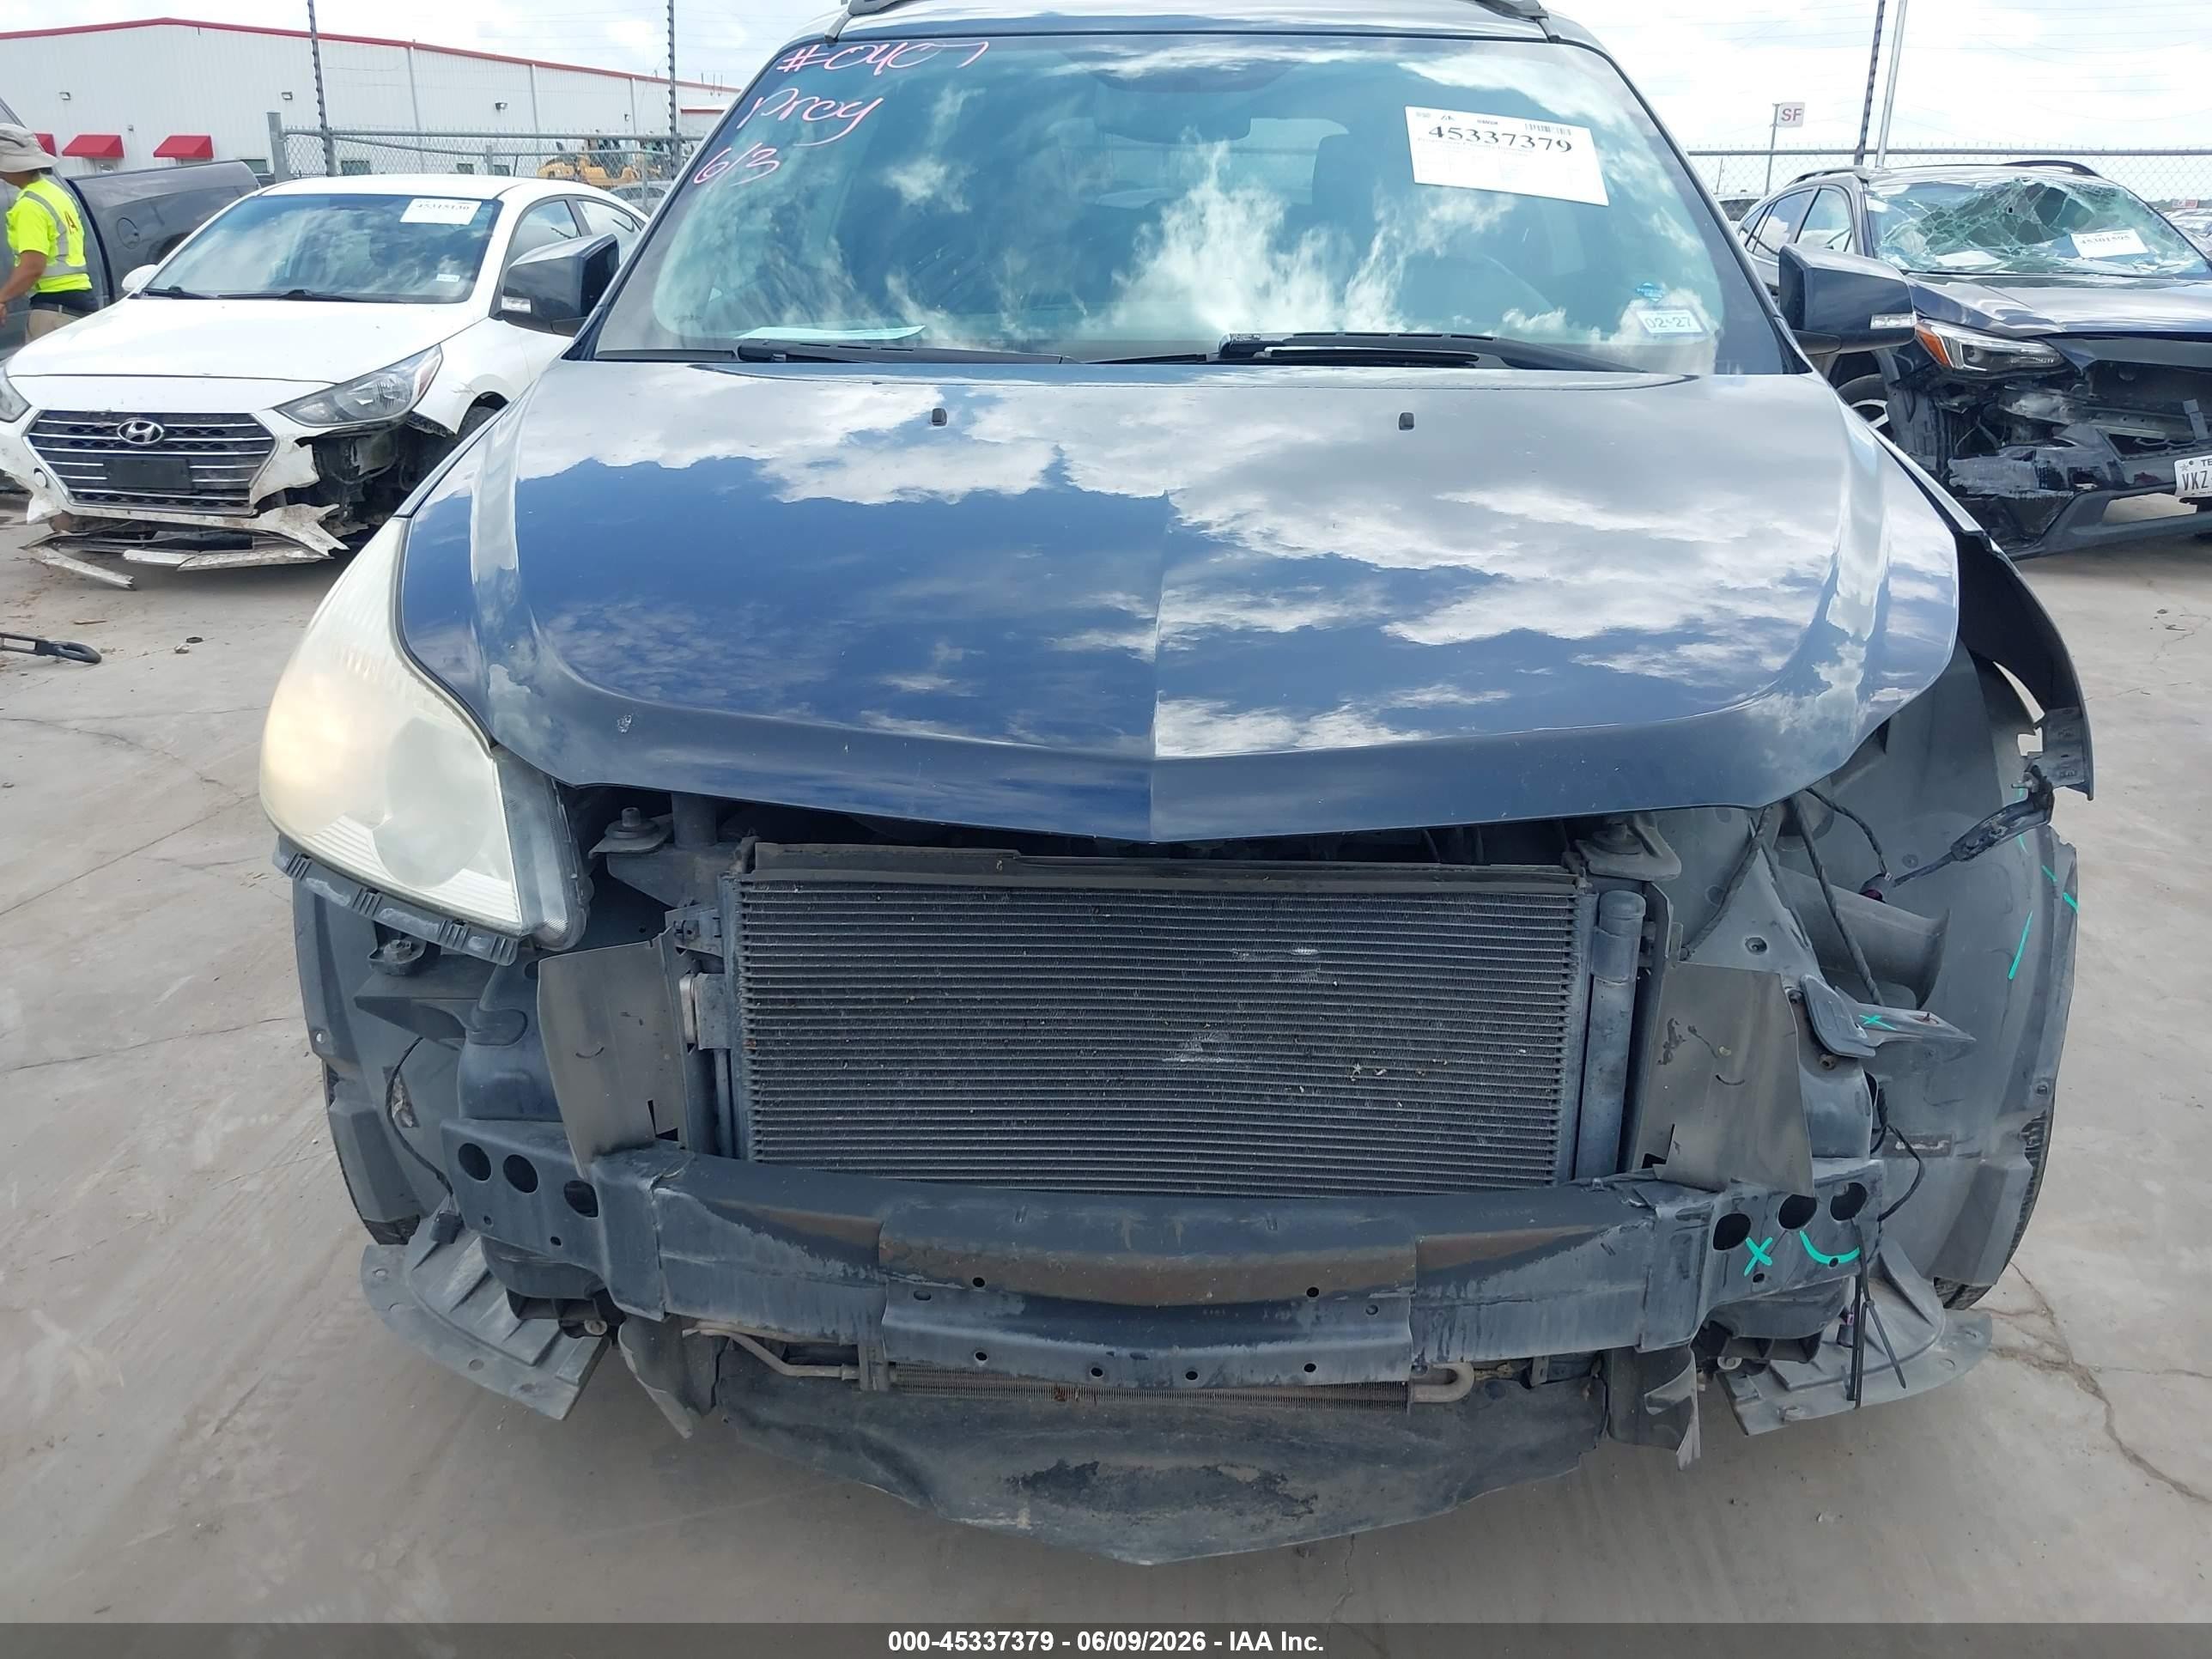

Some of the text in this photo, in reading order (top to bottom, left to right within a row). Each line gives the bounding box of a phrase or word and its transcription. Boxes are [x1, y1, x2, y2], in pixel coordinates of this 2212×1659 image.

[776, 41, 990, 76] #0407
[1781, 108, 1802, 121] SF
[1428, 125, 1572, 153] 45337379
[693, 142, 781, 187] 6/3
